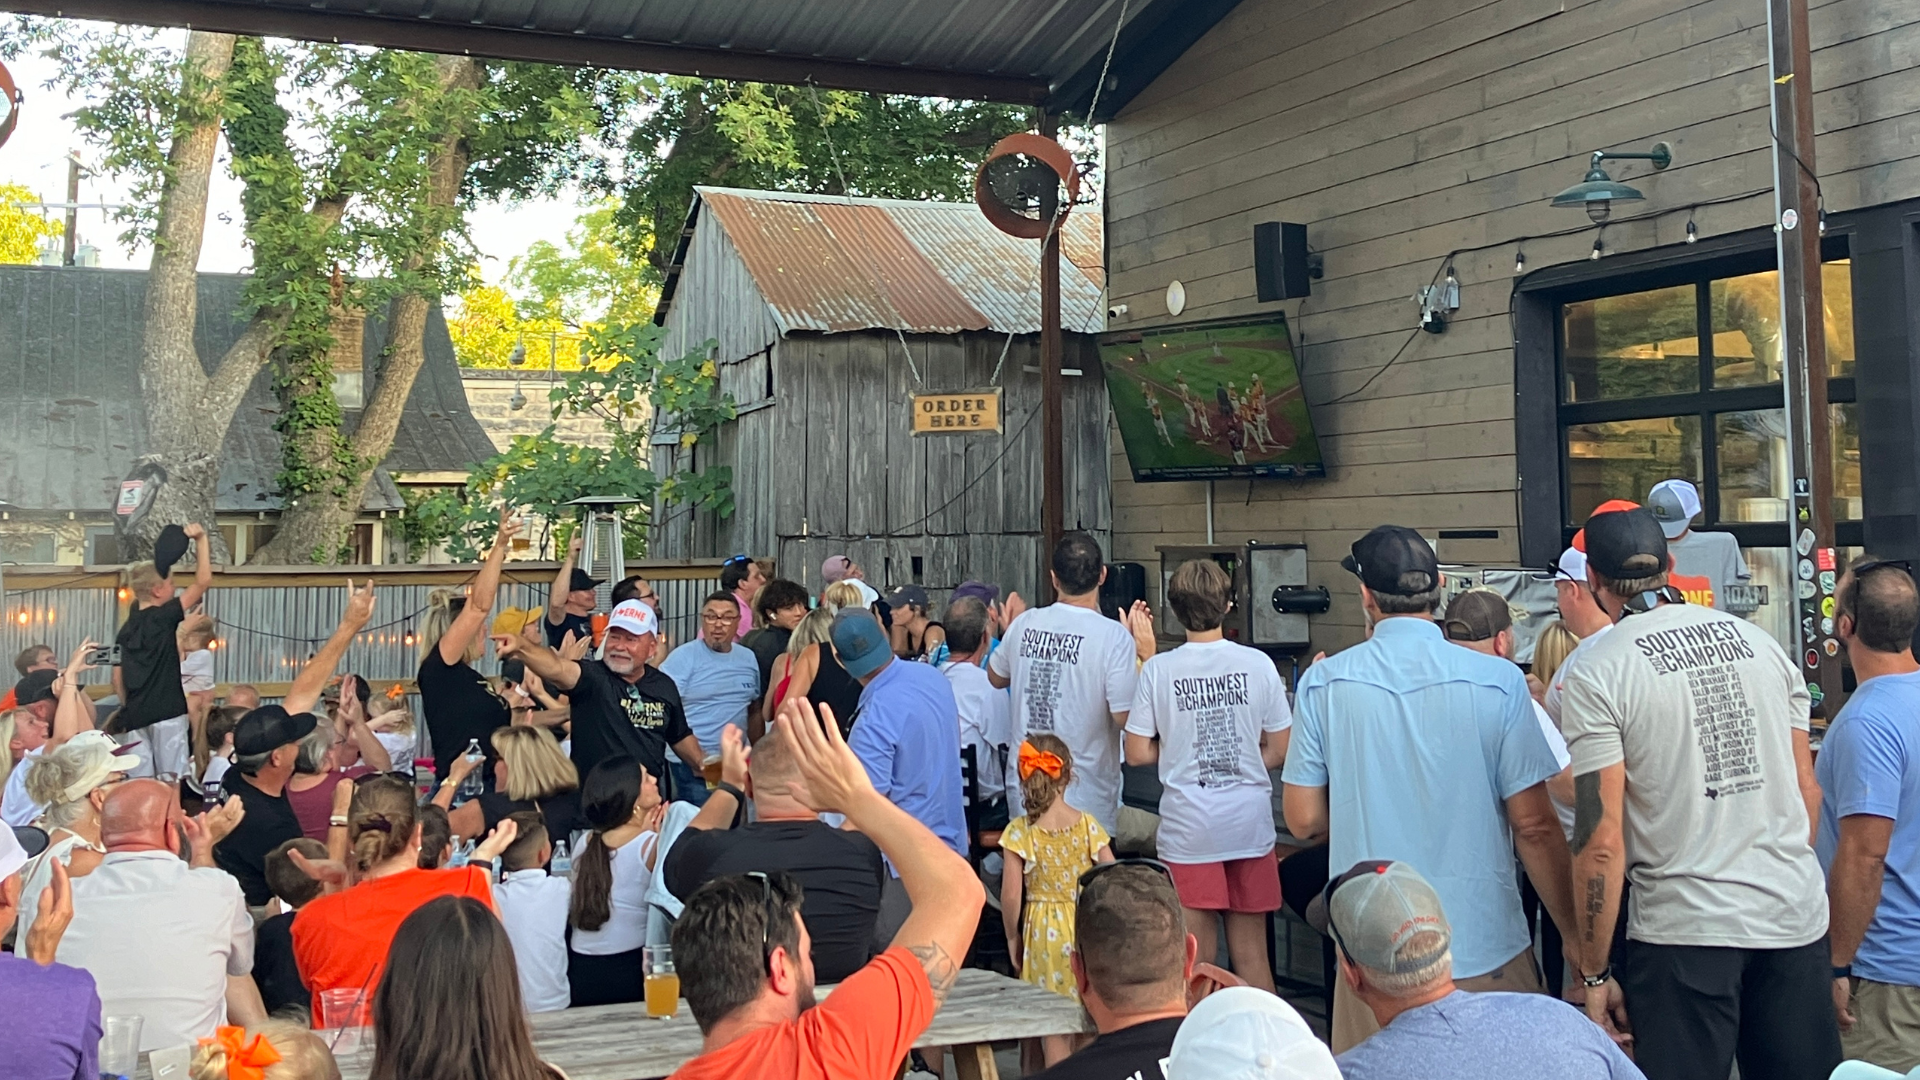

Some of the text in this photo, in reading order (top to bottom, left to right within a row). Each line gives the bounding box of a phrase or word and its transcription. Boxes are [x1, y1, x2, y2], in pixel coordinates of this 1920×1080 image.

[923, 399, 987, 413] ORDER
[931, 414, 981, 427] HERE
[1022, 628, 1085, 652] SOUTHWEST
[1635, 621, 1743, 657] SOUTHWEST
[1025, 644, 1079, 665] CHAMPIONS
[1661, 639, 1755, 672] CHAMPIONS
[1648, 655, 1668, 676] 2024
[1174, 673, 1248, 696] SOUTHWEST
[1185, 690, 1249, 711] CHAMPIONS
